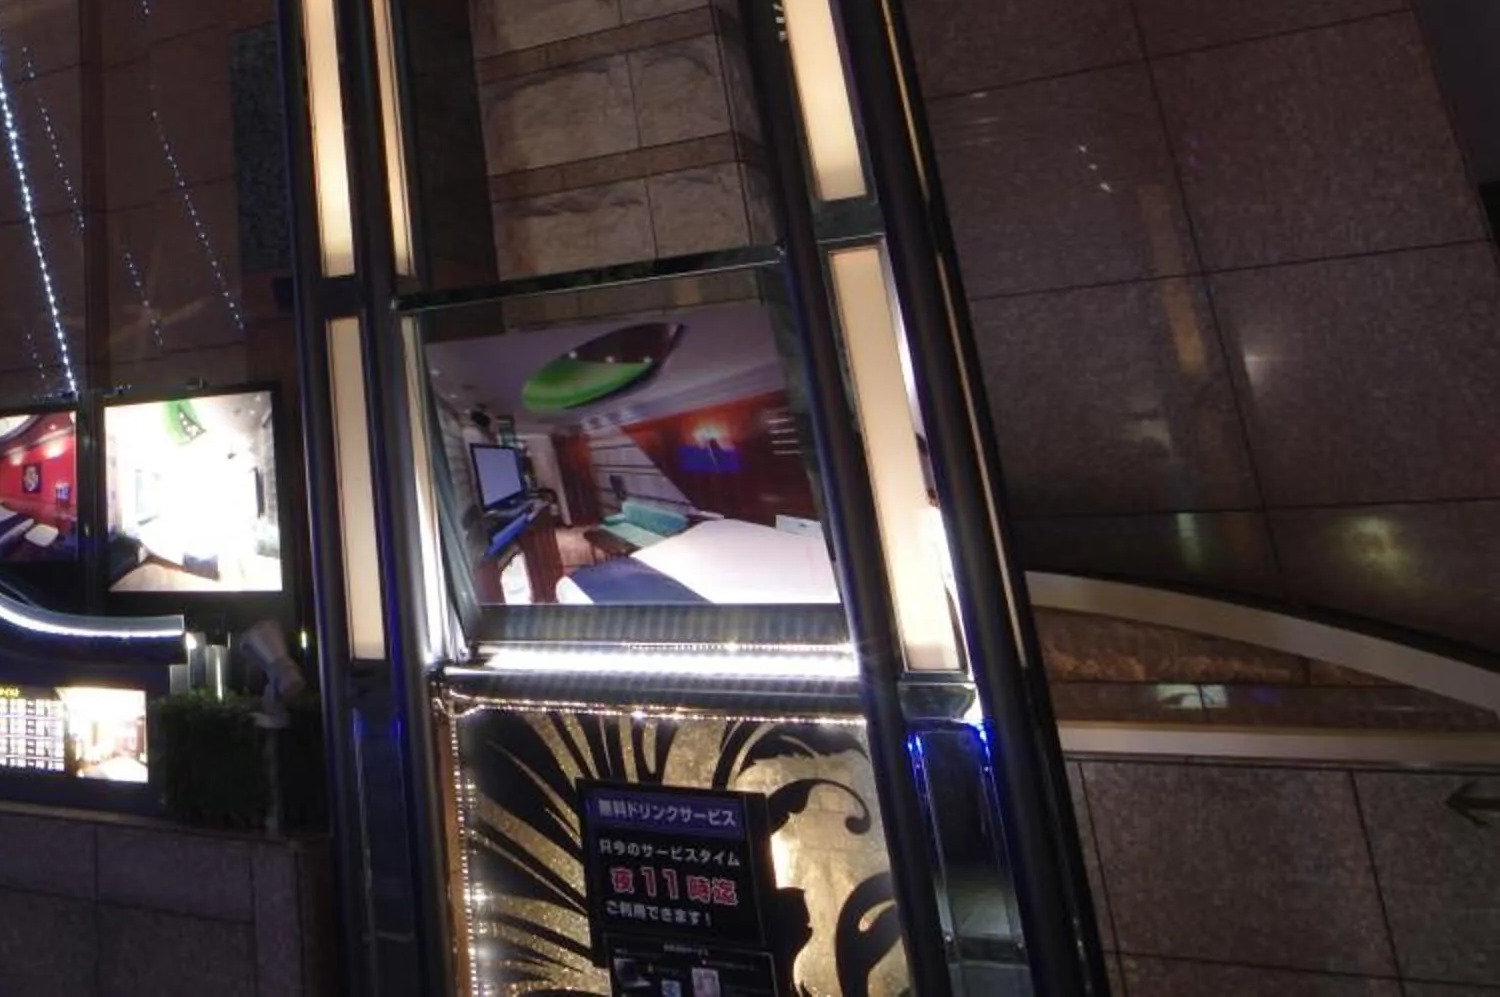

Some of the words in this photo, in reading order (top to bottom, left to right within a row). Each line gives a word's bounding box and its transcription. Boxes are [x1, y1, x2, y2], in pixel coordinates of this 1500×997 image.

[598, 798, 737, 827] 無料ドリンクサービス
[599, 838, 741, 867] 只今のサービスタイム
